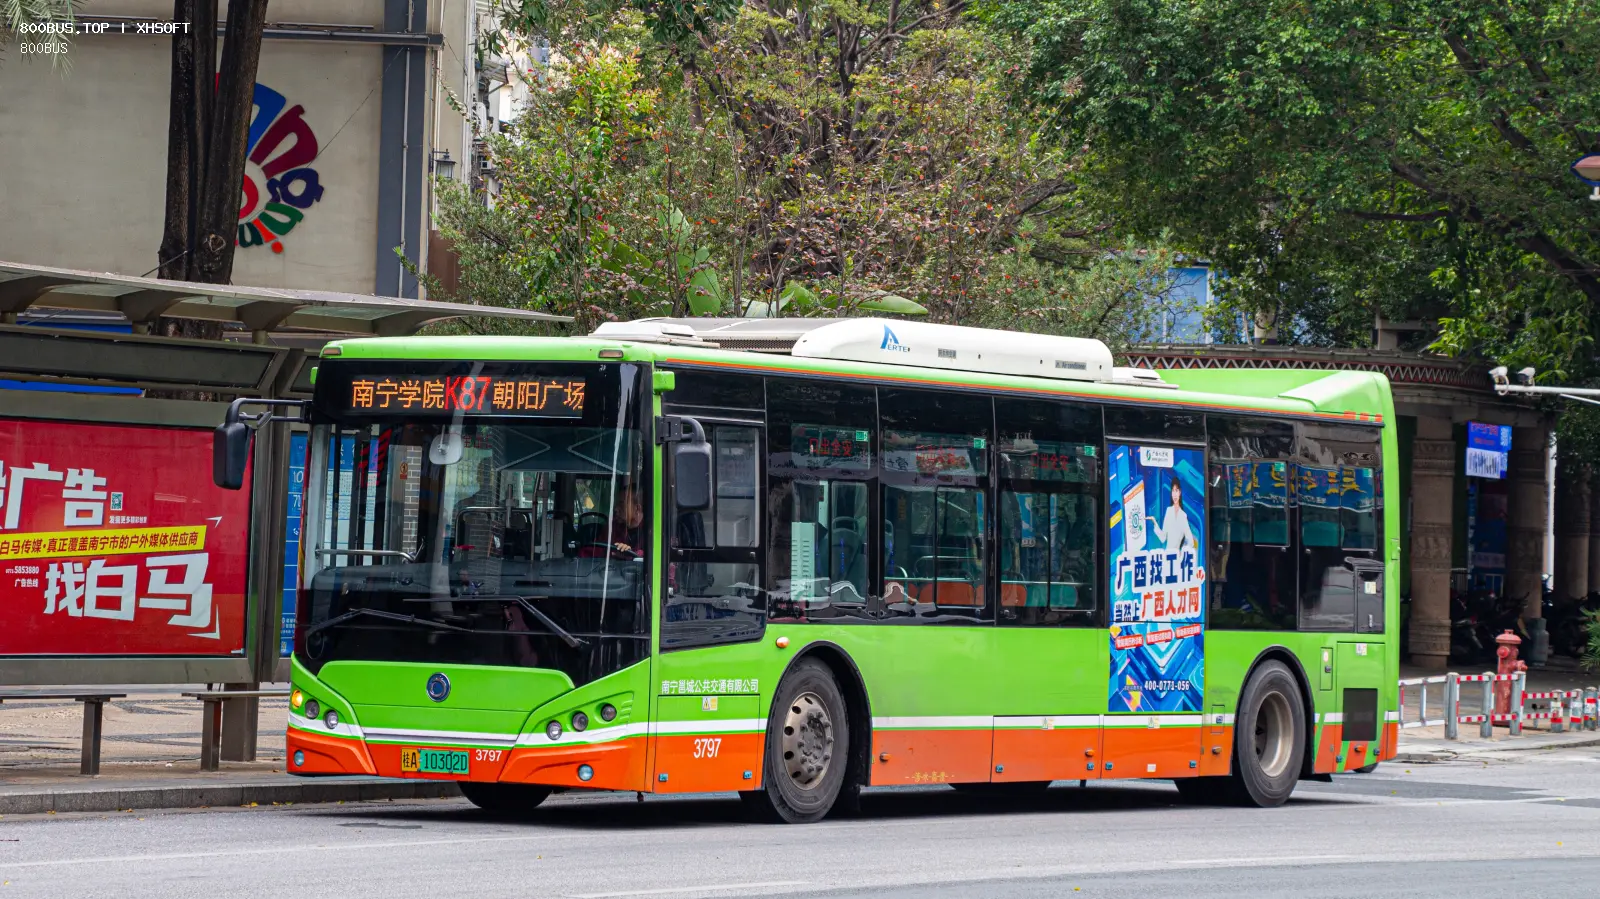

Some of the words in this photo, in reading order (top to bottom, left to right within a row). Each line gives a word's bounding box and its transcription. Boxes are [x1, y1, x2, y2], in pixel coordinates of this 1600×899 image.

[352, 379, 445, 409] 南宁学院
[445, 376, 492, 411] K87
[493, 380, 586, 410] 朝阳广场
[0, 460, 107, 530] 广告
[1117, 551, 1194, 590] 广西找工作
[43, 552, 213, 628] 找白马
[1115, 602, 1140, 623] 当然上
[1141, 587, 1199, 618] 广西人才网
[661, 679, 759, 695] 南宁邕城公共交通有限公司
[1144, 680, 1190, 691] 400-0771-056
[475, 749, 502, 761] 3797
[692, 738, 722, 759] 3797
